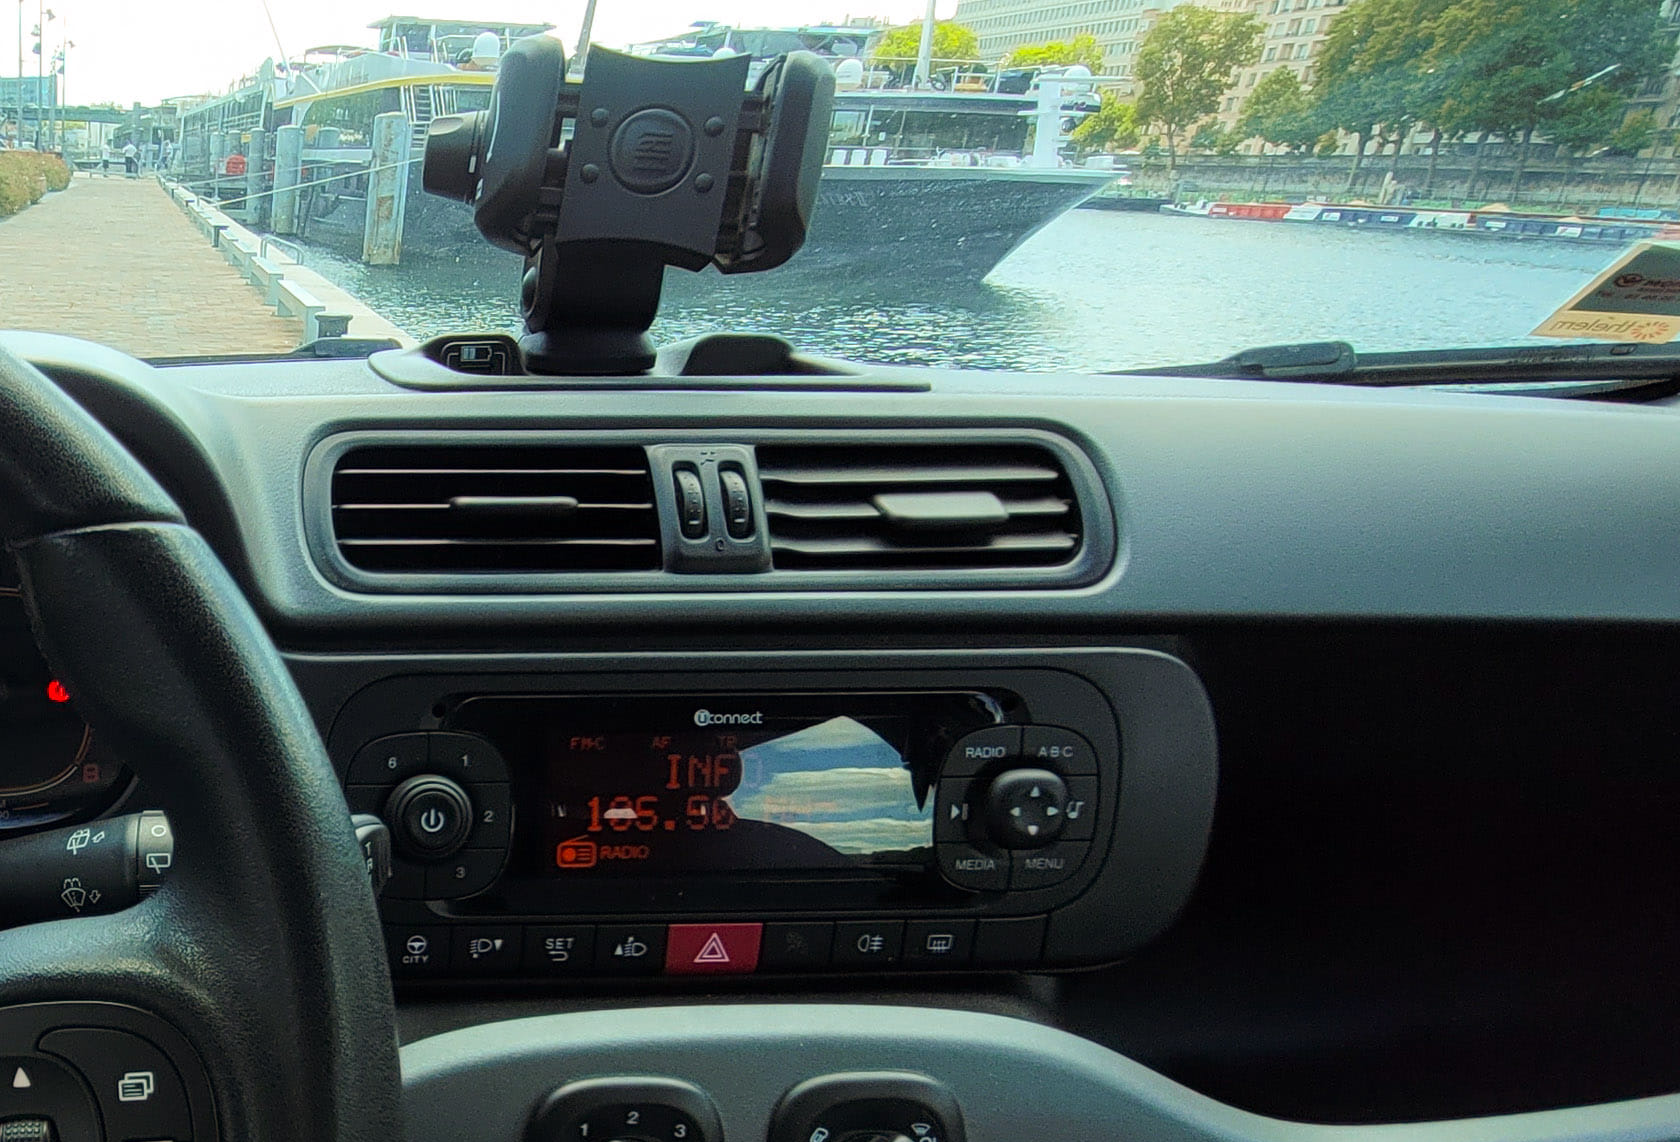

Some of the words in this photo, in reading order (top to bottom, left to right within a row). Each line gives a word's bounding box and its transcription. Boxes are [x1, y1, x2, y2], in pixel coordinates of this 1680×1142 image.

[964, 746, 1006, 759] RADIO
[387, 757, 398, 769] 6
[460, 754, 470, 767] 1
[483, 810, 494, 823] 2
[598, 844, 651, 861] RADIO
[954, 858, 997, 871] MEDIA
[1024, 857, 1065, 870] MENU
[455, 866, 466, 878] 3
[544, 937, 575, 950] SET
[402, 955, 430, 964] CITY
[626, 1110, 640, 1125] 2
[579, 1123, 589, 1137] 1
[674, 1123, 687, 1138] 3
